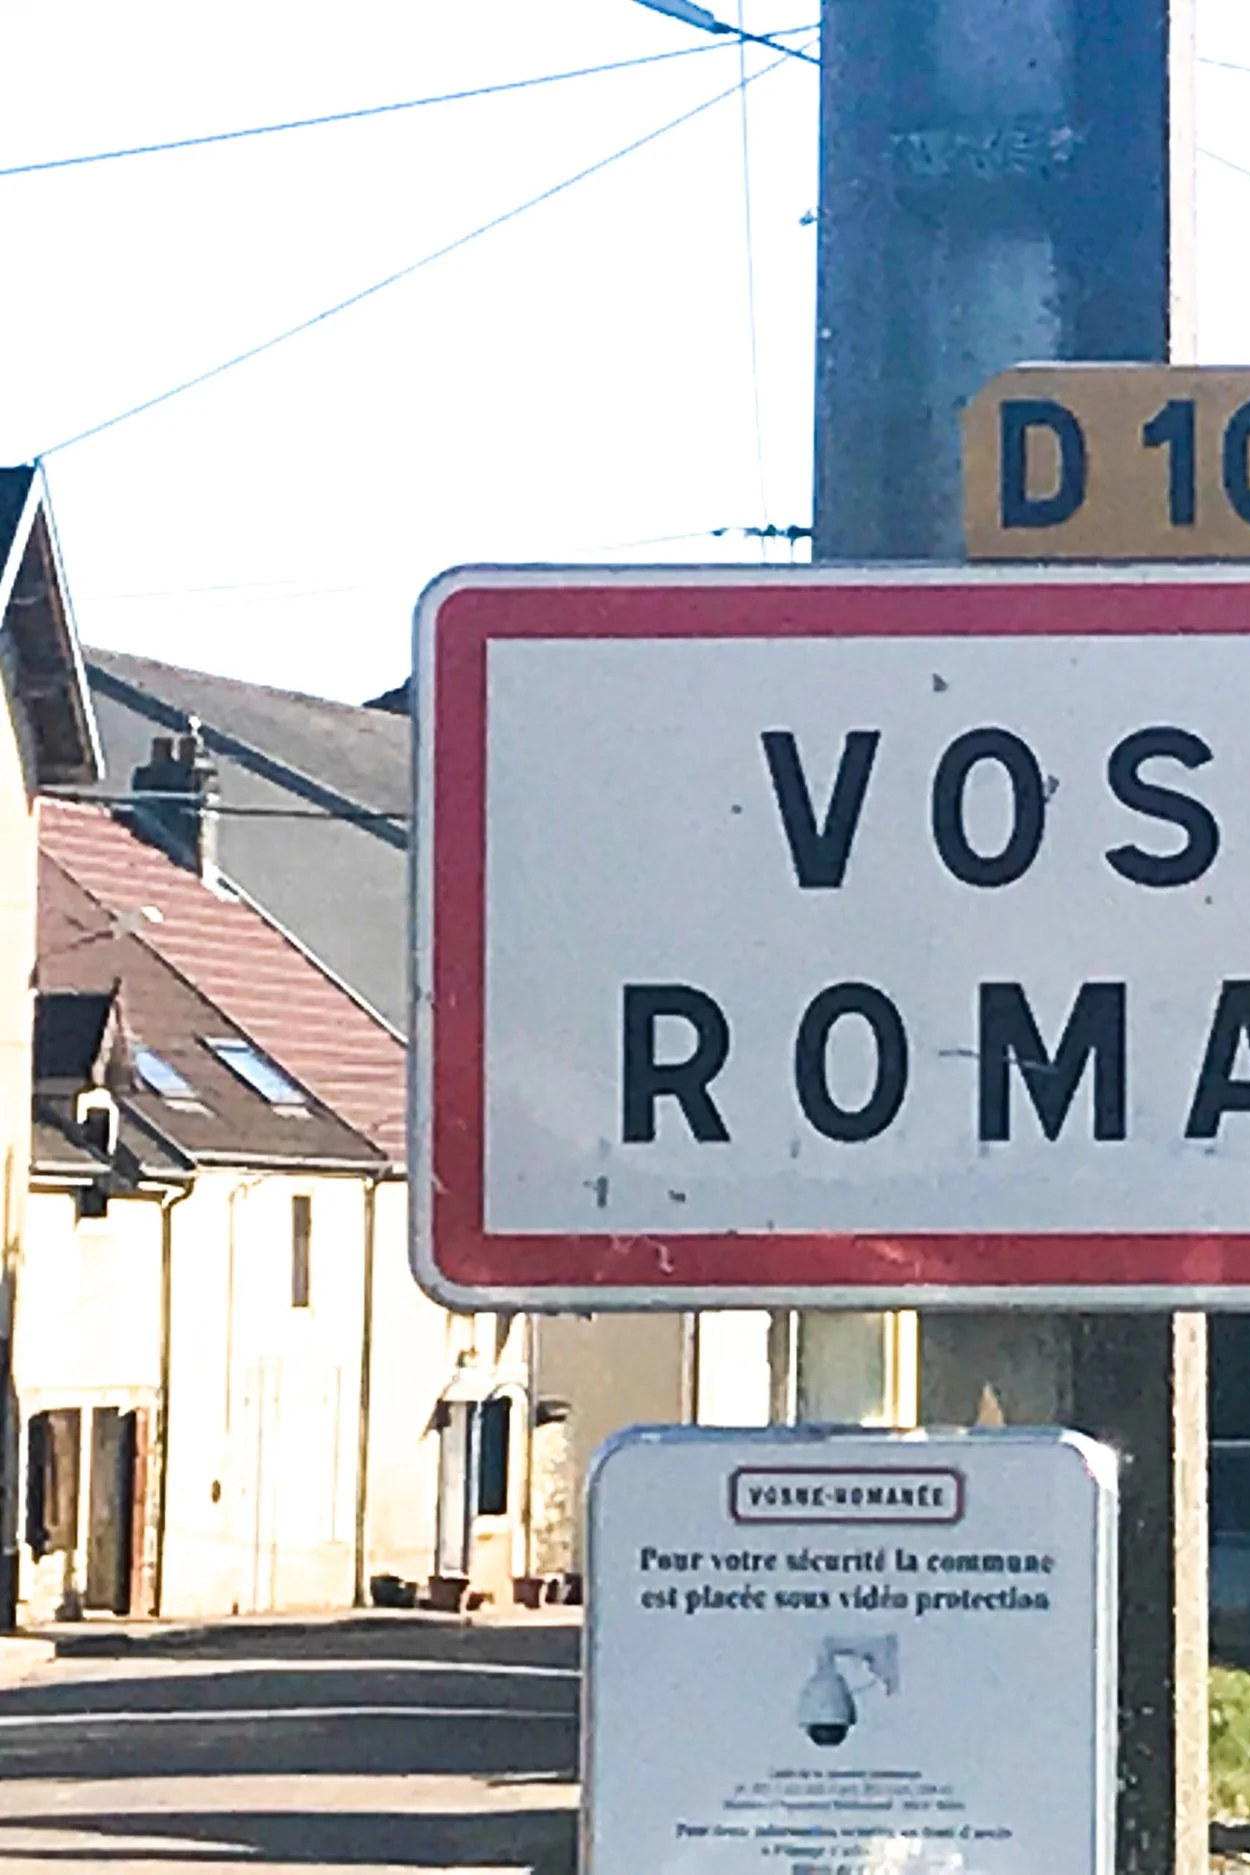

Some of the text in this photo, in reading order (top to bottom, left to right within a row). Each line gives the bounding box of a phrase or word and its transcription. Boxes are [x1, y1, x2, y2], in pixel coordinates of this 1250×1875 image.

[1000, 398, 1088, 528] D
[640, 1547, 1054, 1573] Pour votre sécurité la commune
[640, 1583, 1051, 1615] est placée sous vidéo protection
